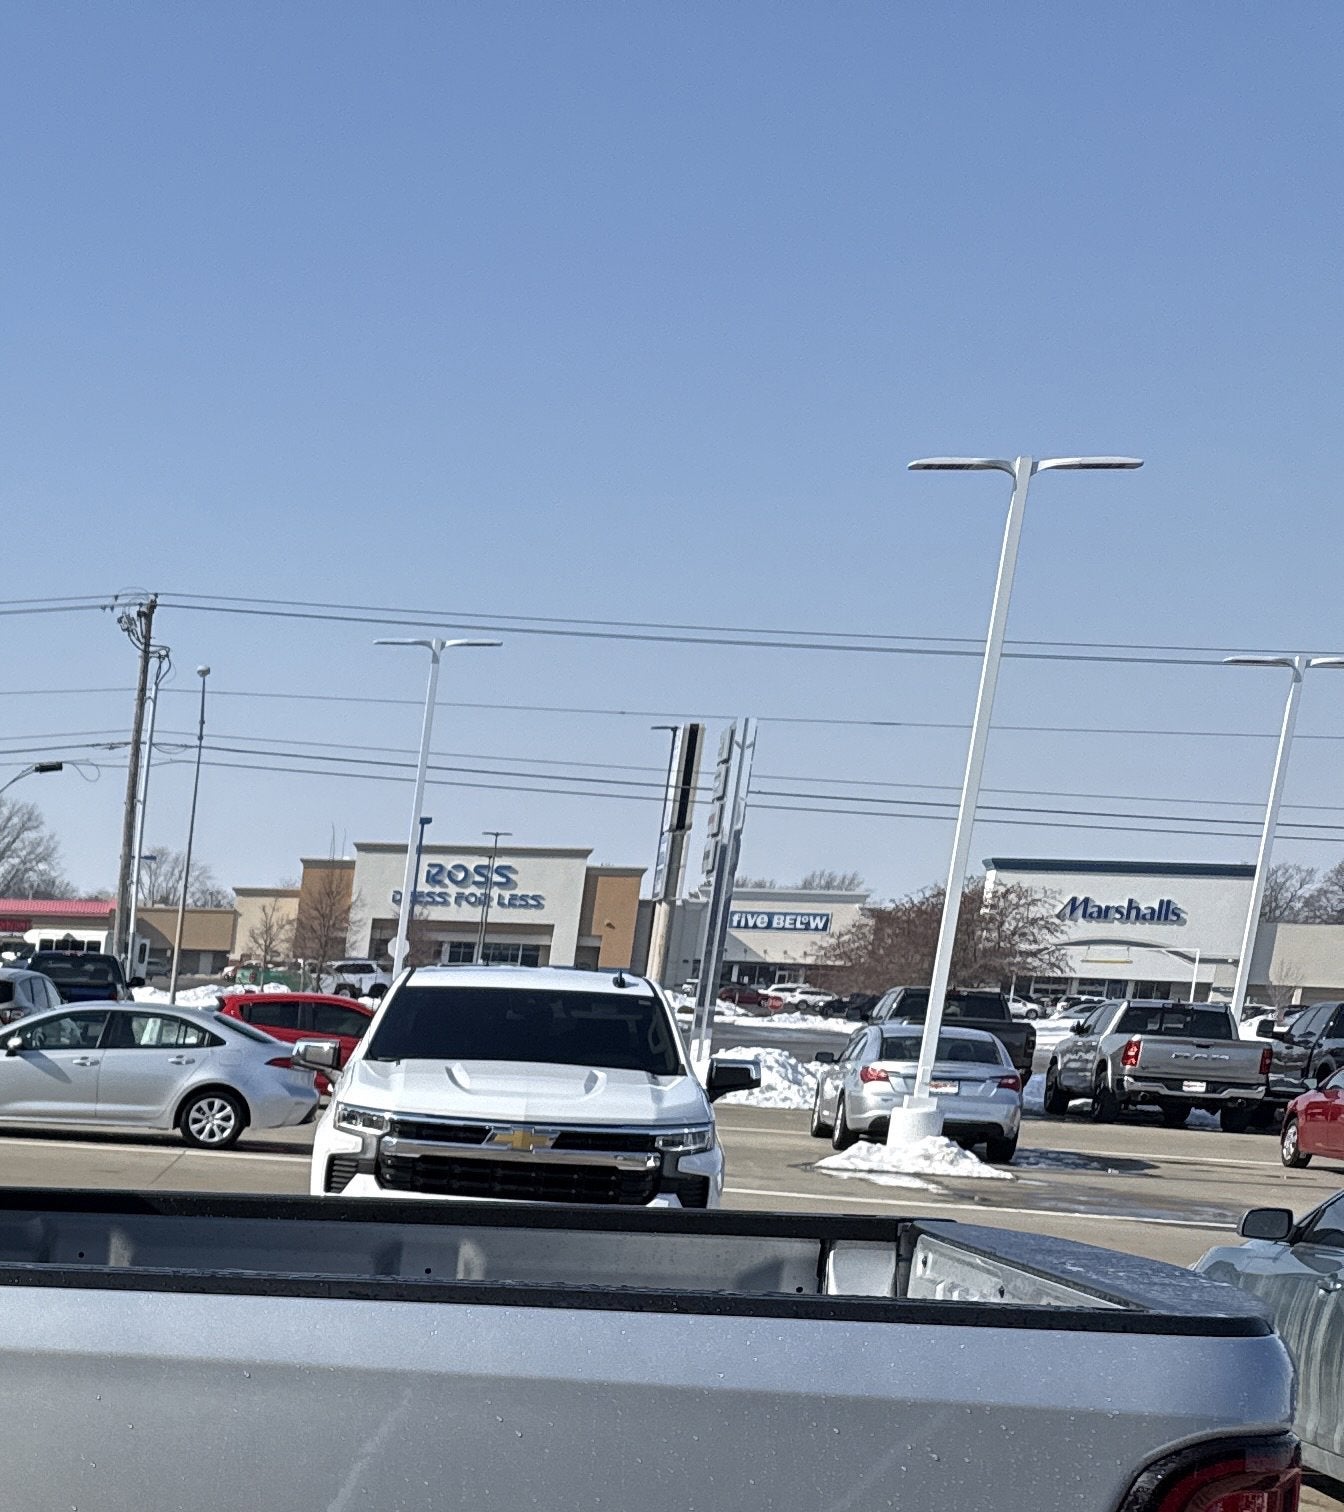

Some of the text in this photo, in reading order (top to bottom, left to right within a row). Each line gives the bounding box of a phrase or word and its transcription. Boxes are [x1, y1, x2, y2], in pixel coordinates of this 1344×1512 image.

[425, 863, 518, 889] ROSS
[392, 890, 545, 909] DESS FOR LESS
[1057, 896, 1185, 925] Marshalls
[732, 912, 769, 928] five
